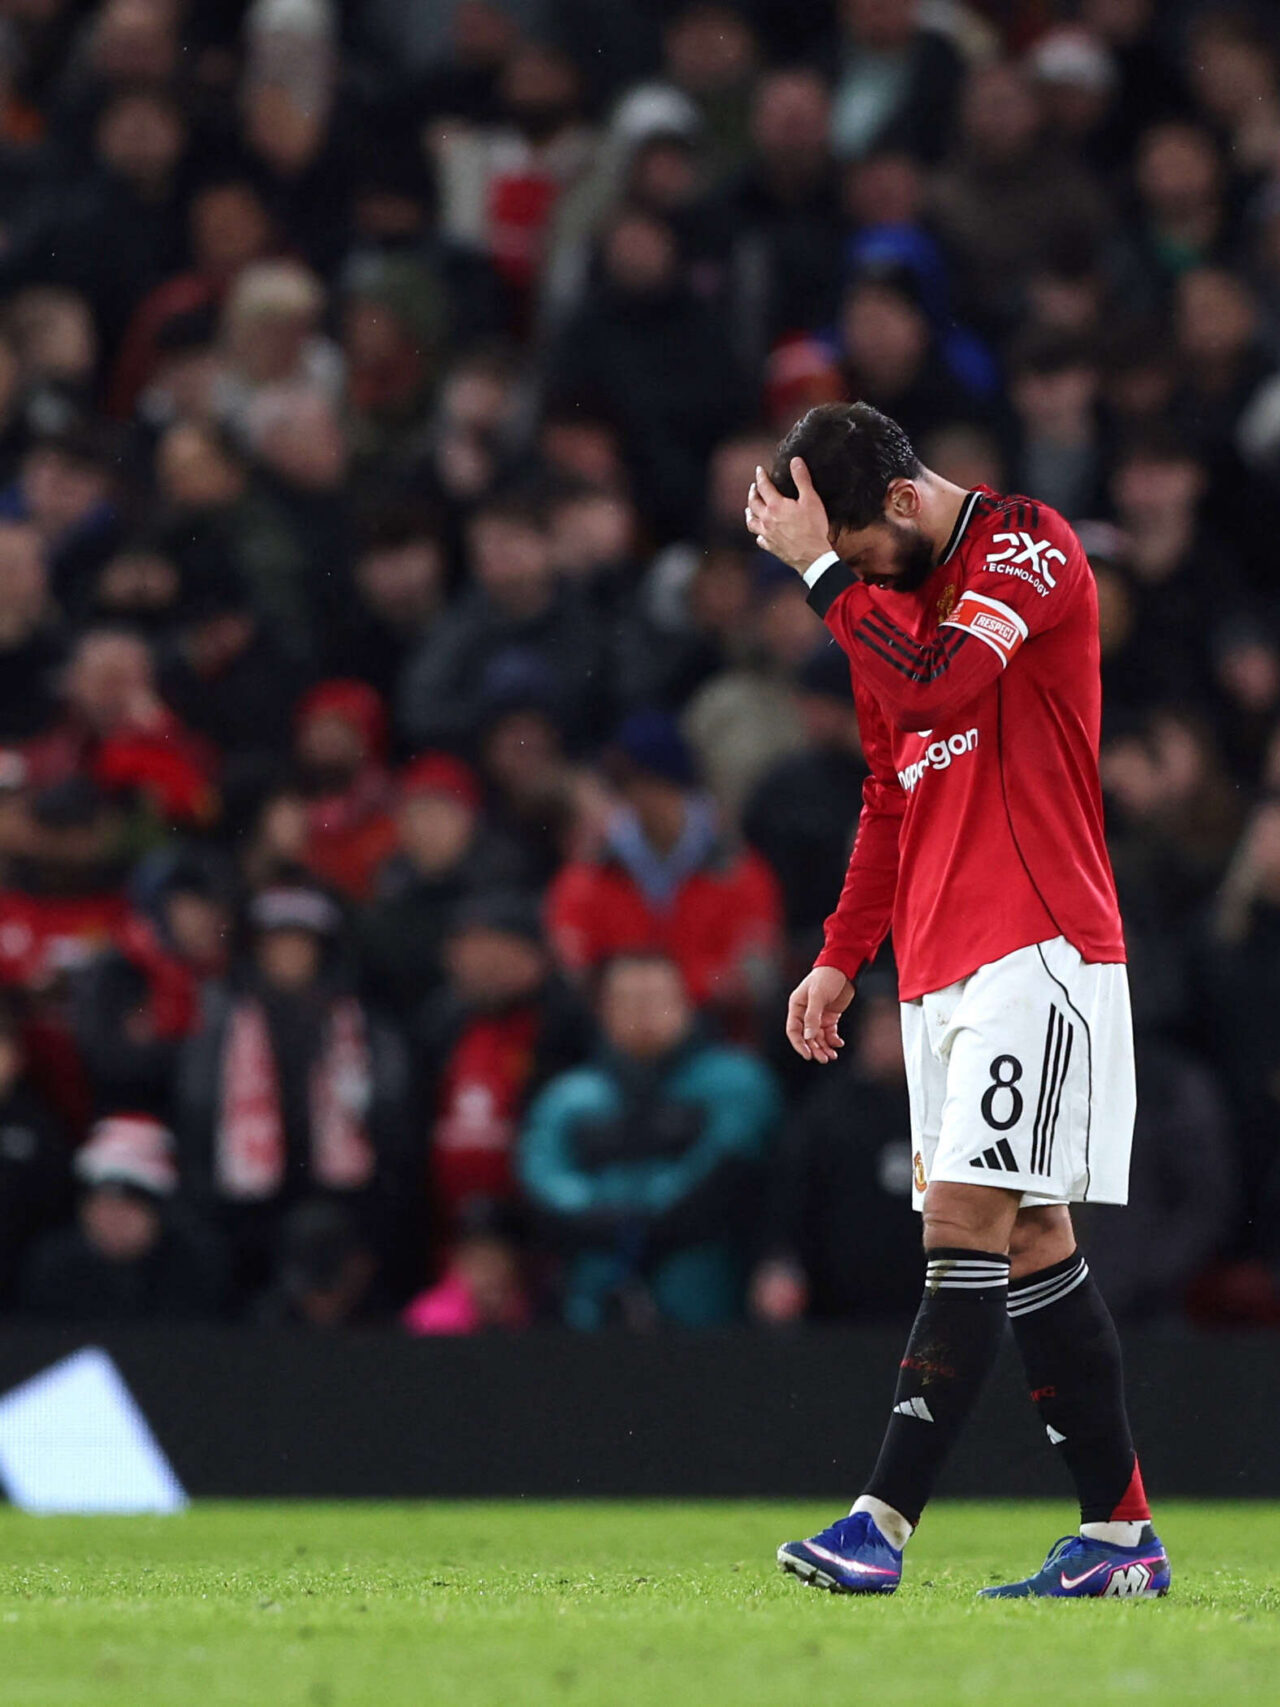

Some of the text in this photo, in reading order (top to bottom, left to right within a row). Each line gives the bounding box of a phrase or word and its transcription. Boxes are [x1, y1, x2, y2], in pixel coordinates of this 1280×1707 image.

[982, 562, 1051, 598] ECHNOLOGY
[976, 615, 1014, 643] RESPECT
[980, 1053, 1024, 1131] 8
